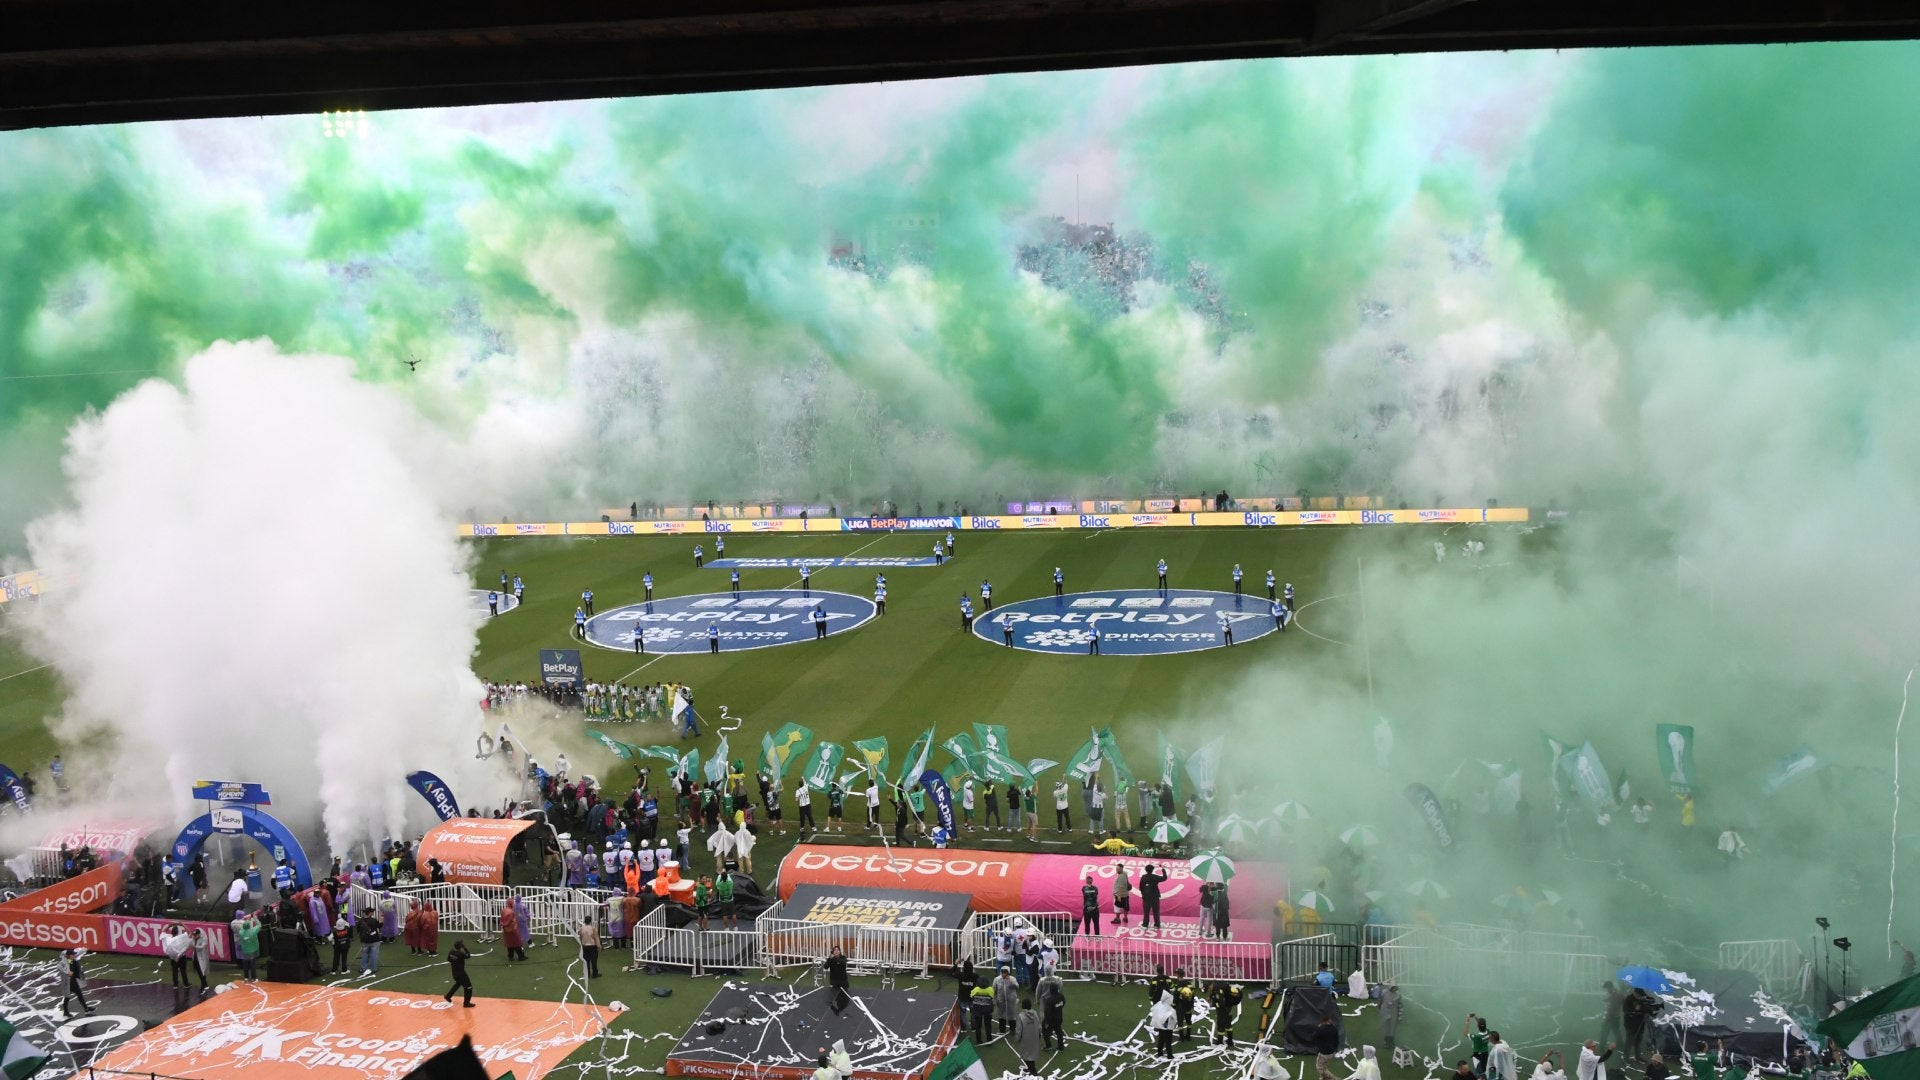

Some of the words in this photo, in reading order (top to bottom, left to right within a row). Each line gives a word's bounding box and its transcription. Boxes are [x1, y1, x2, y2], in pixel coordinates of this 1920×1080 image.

[848, 520, 869, 529] LIGA
[871, 518, 909, 530] BetPlay
[909, 519, 954, 529] DIMAYOR
[972, 517, 1001, 529] Bilac
[1080, 515, 1110, 527] Bilac
[1244, 511, 1276, 525] Bilac
[608, 521, 635, 534] Bilac
[704, 520, 732, 532] Bilac
[605, 610, 800, 625] BetPlay
[991, 611, 1207, 625] BetPlay
[1104, 632, 1217, 640] DIMAYOR
[543, 663, 578, 675] BetPlay
[456, 863, 497, 872] Cooperativa
[795, 851, 1010, 878] betsson
[456, 869, 490, 878] Financiera
[815, 896, 845, 906] UN
[841, 897, 944, 912] ESCENARIO
[809, 904, 901, 917] LLAMADO
